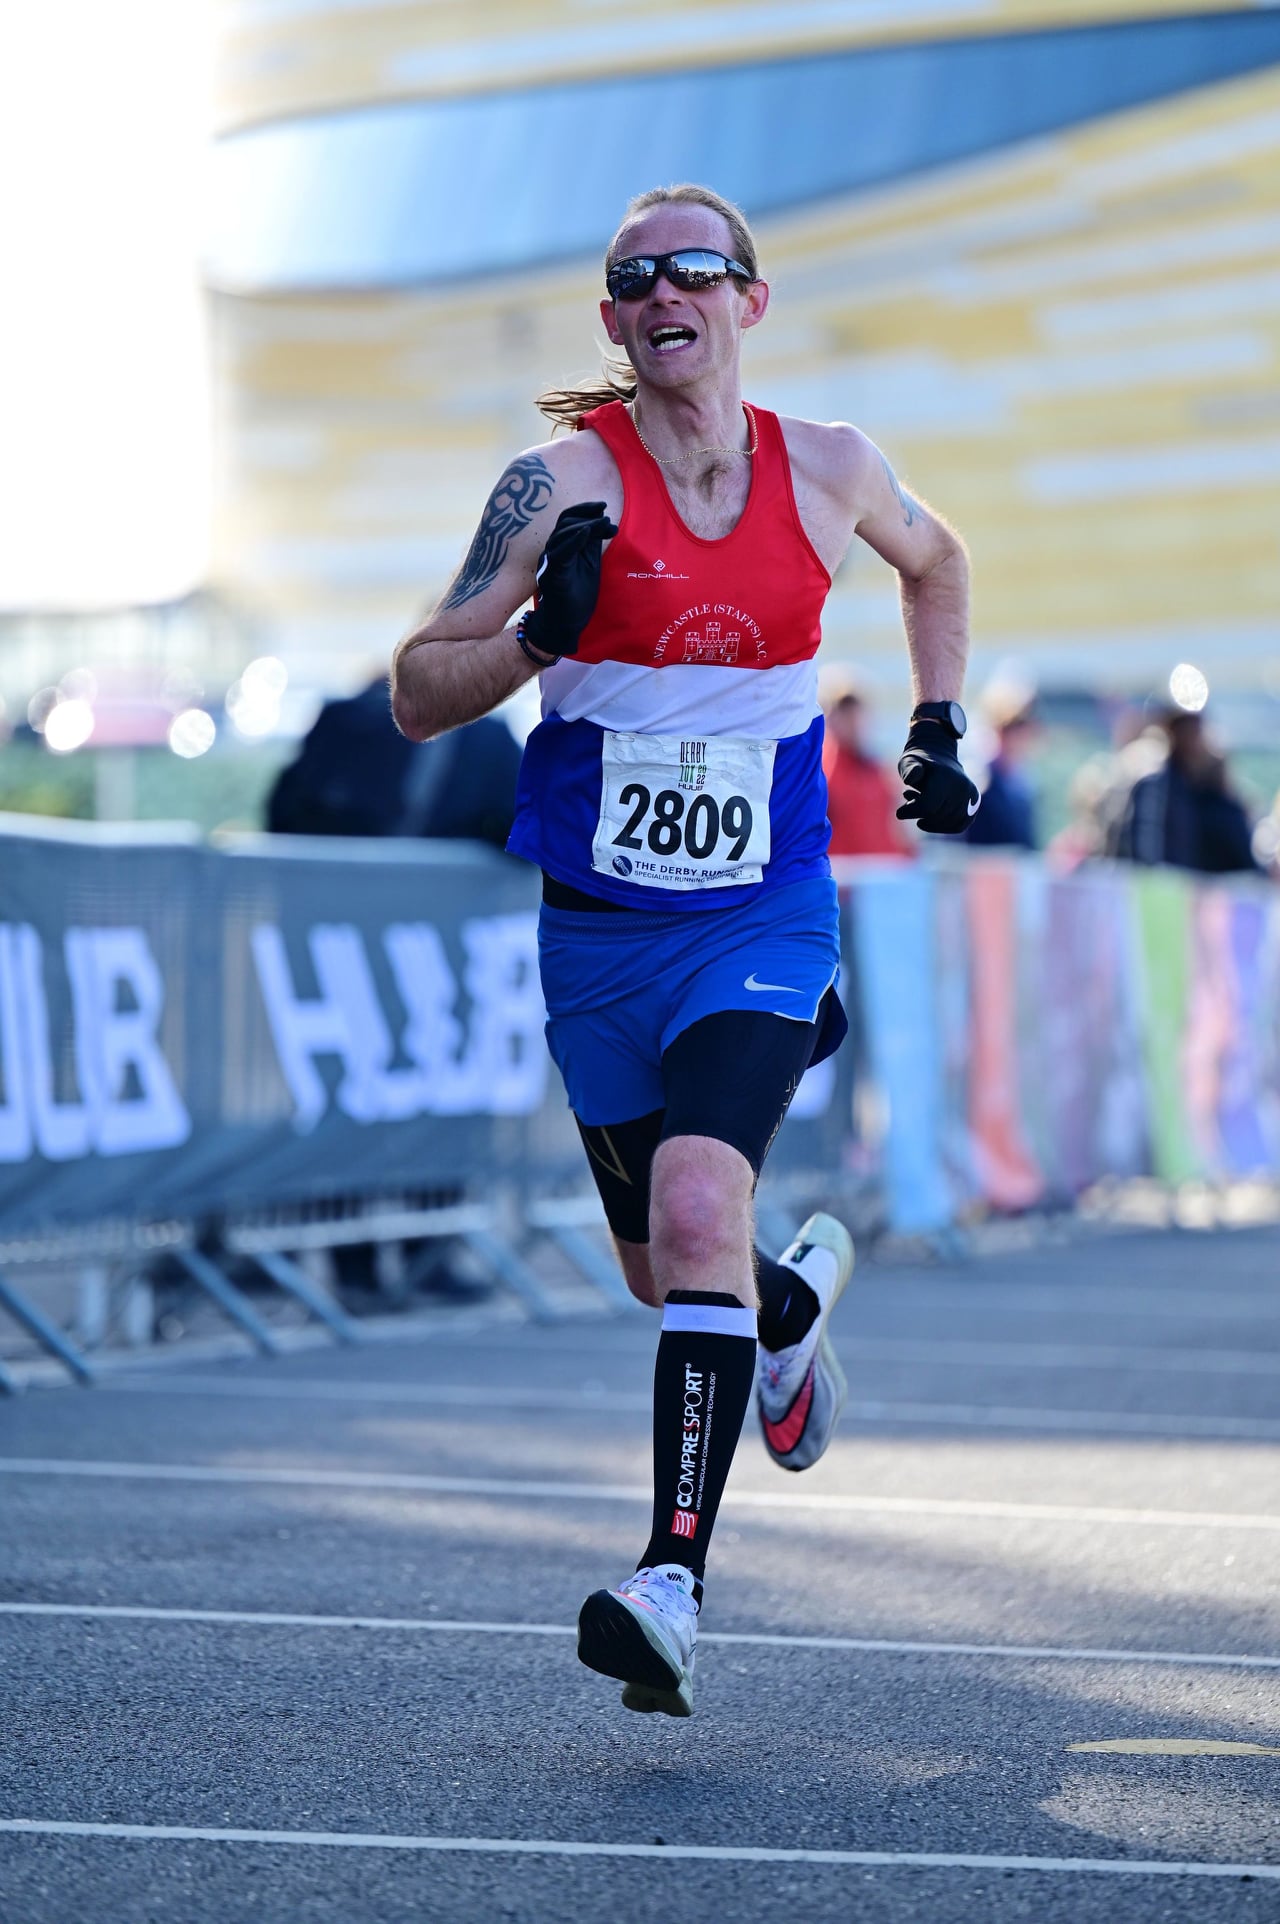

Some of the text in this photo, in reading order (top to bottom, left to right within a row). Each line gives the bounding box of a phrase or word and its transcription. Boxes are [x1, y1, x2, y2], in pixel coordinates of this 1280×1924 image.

[653, 603, 711, 661] NEWCASTLE
[713, 603, 763, 639] (STAFFS)
[680, 741, 707, 763] DERBY
[678, 764, 696, 783] 10K
[611, 783, 753, 862] 2809
[634, 860, 657, 872] THE
[660, 865, 698, 876] DERBY
[634, 870, 673, 882] SPECIALIST
[707, 1371, 717, 1412] TECHNOLOGY
[702, 1413, 713, 1458] COMPRESSION
